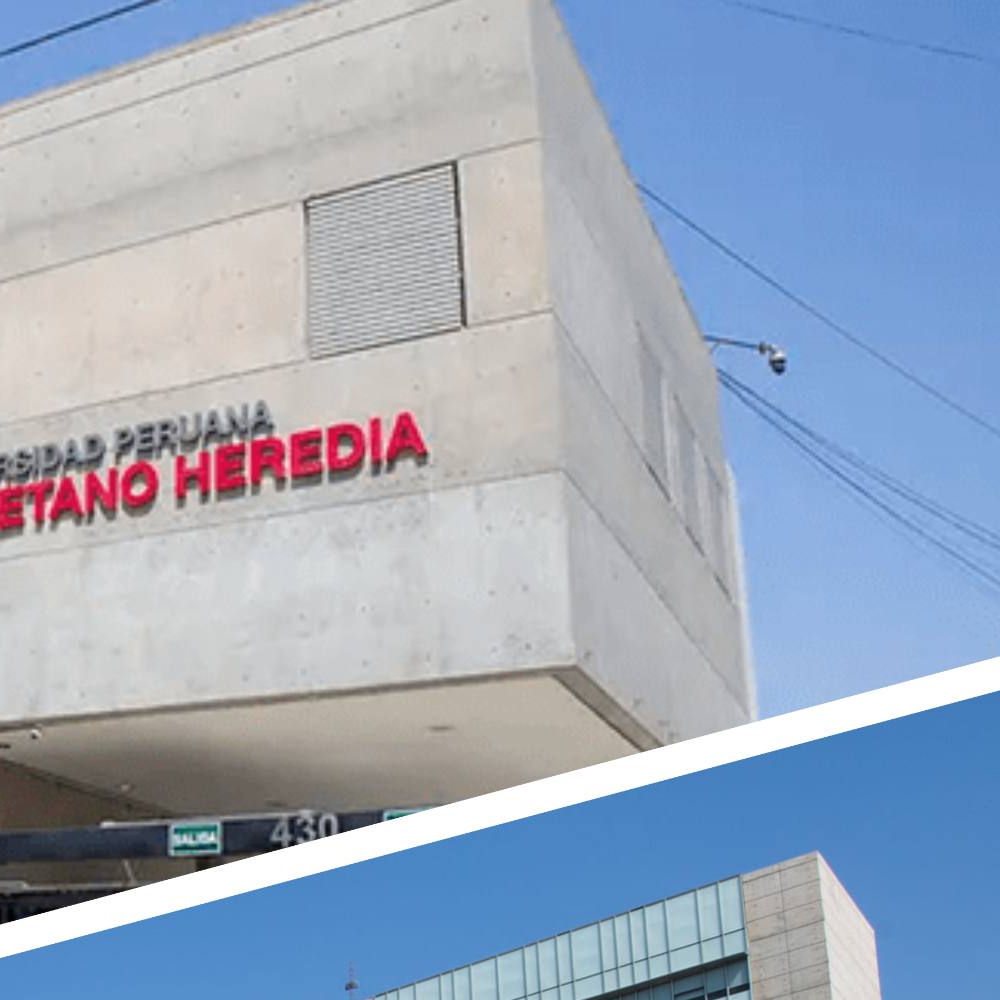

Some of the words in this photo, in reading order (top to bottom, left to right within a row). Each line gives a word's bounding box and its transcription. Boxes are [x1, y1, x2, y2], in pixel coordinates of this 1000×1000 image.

[114, 400, 275, 463] PERUANA
[174, 411, 429, 502] HEREDIA
[269, 810, 338, 847] 430
